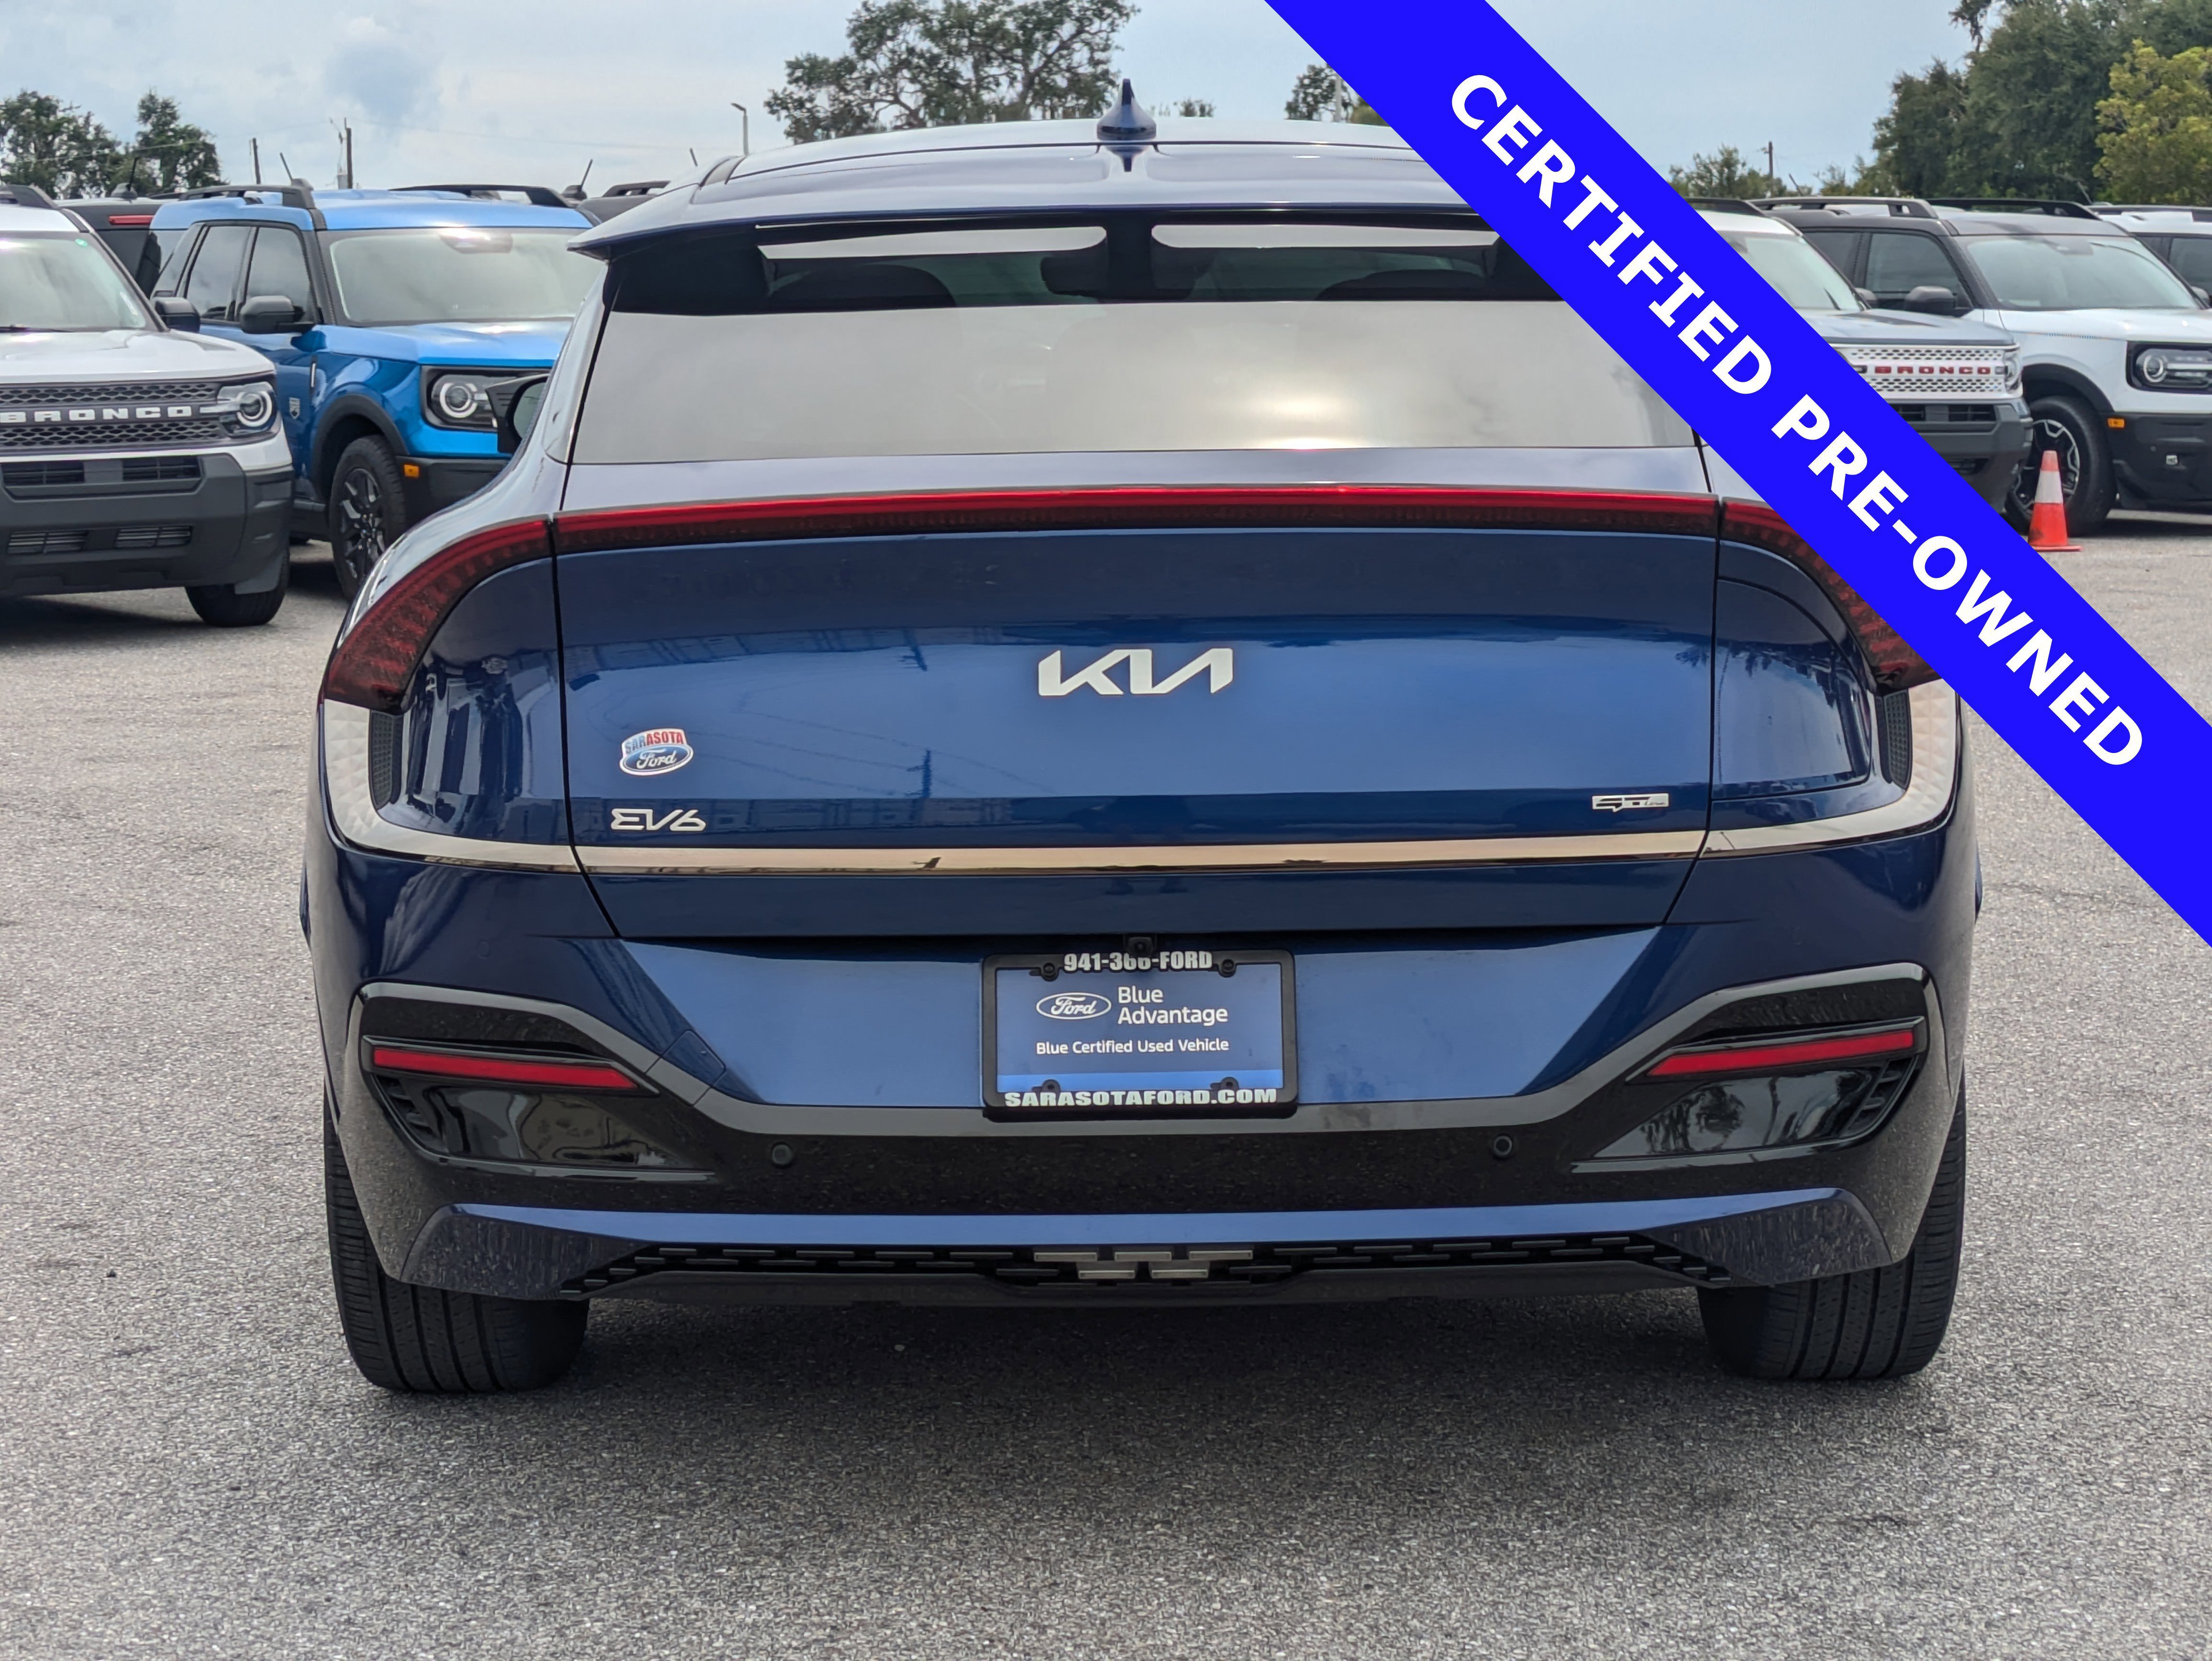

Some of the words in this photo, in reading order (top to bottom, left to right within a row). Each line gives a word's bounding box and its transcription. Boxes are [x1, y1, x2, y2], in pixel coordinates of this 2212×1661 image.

[1874, 365, 1991, 375] BRONCO
[0, 406, 192, 423] BRONCO
[1038, 648, 1234, 697] KIA
[625, 731, 684, 754] SARASOTA
[636, 748, 677, 769] Ford
[610, 808, 707, 832] EV6
[1117, 985, 1163, 1004] Blue
[1051, 996, 1097, 1015] Ford
[1117, 1007, 1228, 1027] Advantage
[1036, 1041, 1069, 1054] Blue
[1072, 1040, 1133, 1054] Certified
[1137, 1039, 1173, 1052] Used
[1178, 1038, 1230, 1052] Vehicle
[1005, 1088, 1277, 1107] SARASOTAFORD.COM
